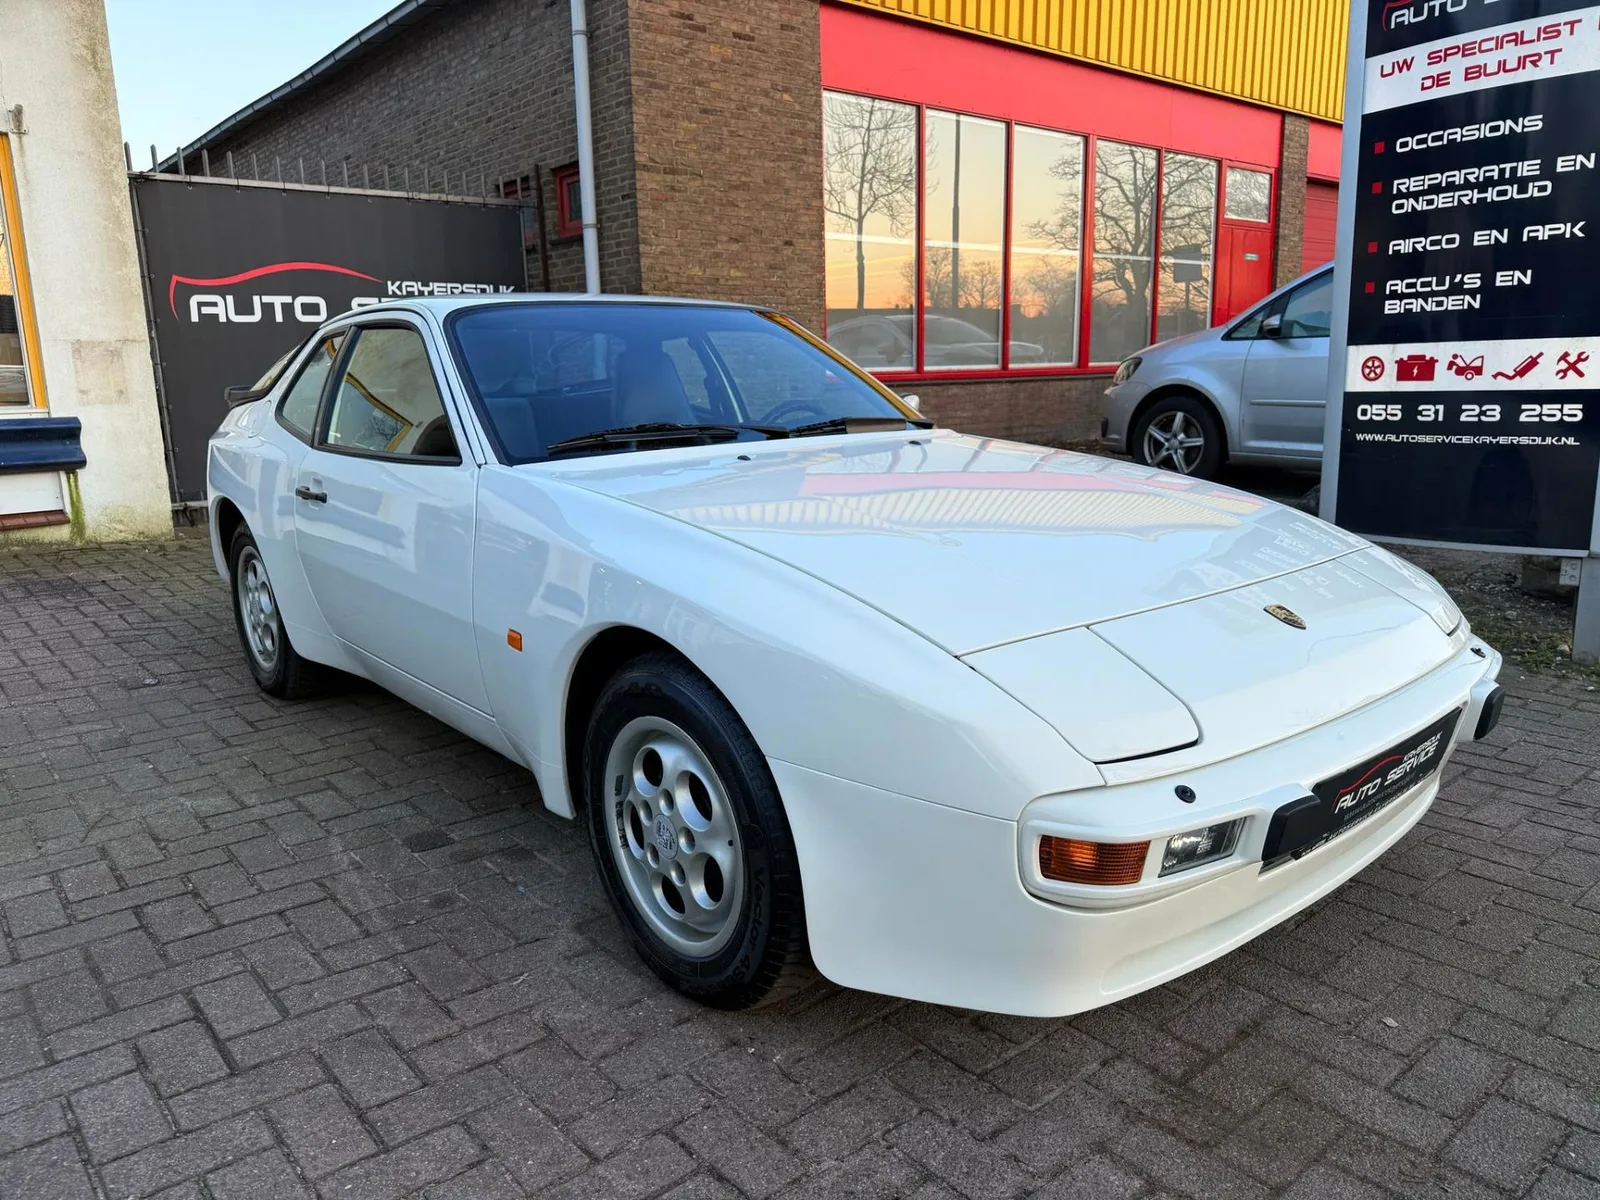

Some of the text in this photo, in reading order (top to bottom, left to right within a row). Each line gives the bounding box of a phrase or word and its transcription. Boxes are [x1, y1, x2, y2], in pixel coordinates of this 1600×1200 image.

[1390, 0, 1467, 29] AUTO
[1380, 56, 1415, 78] UW
[1427, 18, 1582, 66] SPECIALIST
[1420, 48, 1562, 91] DE BUURT
[1396, 114, 1543, 153] OCCASIONS
[1392, 152, 1596, 194] REPARATIE EN
[1391, 180, 1552, 214] ONDERHOUD
[1388, 220, 1587, 255] AIRCO EN APK
[1385, 269, 1532, 295] ACCU'S EN
[189, 294, 328, 323] AUTO
[1384, 294, 1481, 314] BANDEN
[1356, 404, 1584, 422] 055 31 23 255
[1355, 433, 1581, 446] WWW.AUTOSERVICEKAYERSDIJK.NL
[1334, 777, 1381, 814] AUTO
[1384, 740, 1440, 786] SERVICE
